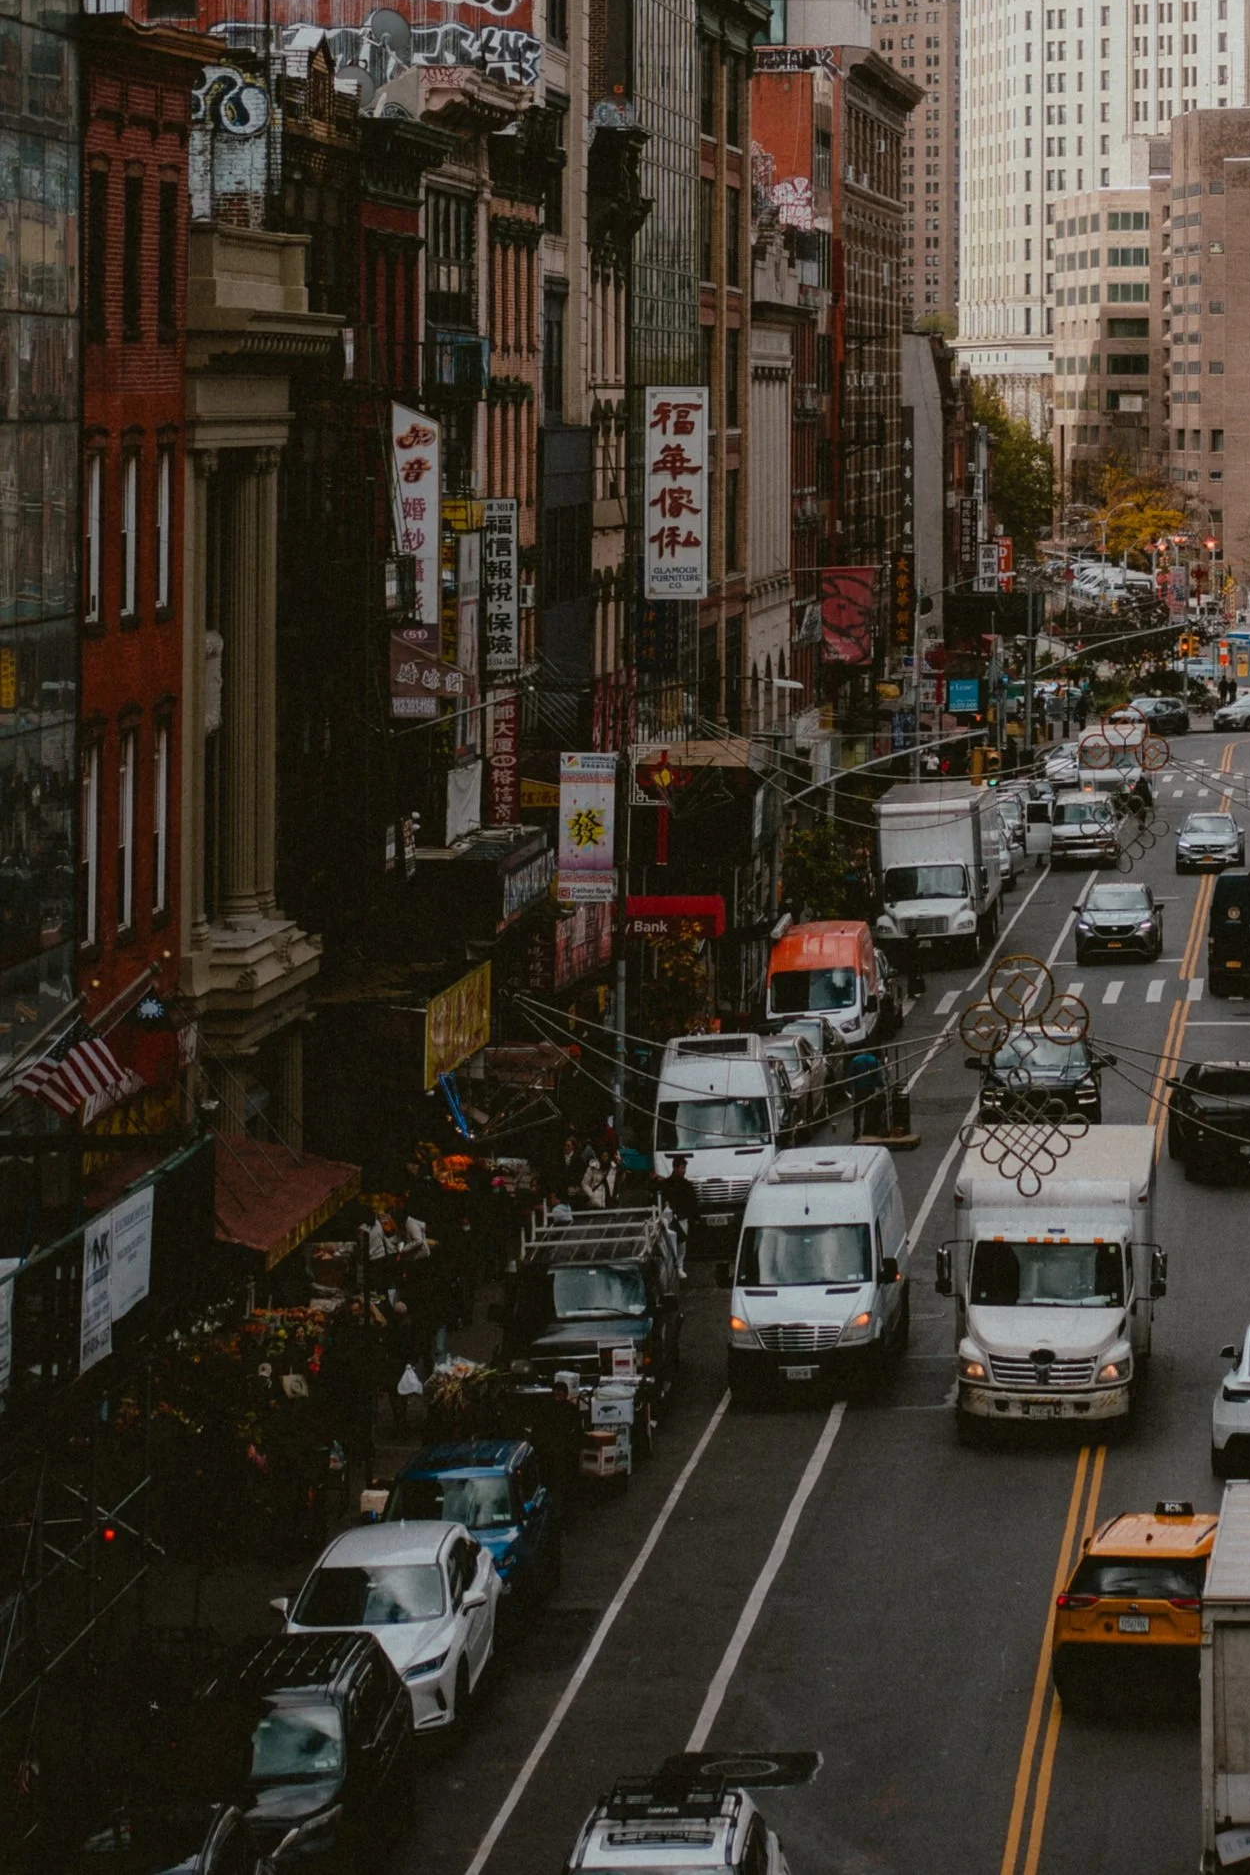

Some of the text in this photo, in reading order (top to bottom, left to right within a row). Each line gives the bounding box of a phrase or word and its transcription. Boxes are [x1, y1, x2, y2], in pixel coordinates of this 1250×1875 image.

[395, 425, 435, 484] 知音
[649, 401, 703, 558] 福華傢俬
[653, 566, 698, 574] GLAMOUR
[651, 574, 700, 582] FURNITURE
[571, 809, 602, 846] 發
[571, 886, 612, 896] Cathay Bank
[571, 893, 608, 901] Foundation
[634, 921, 668, 933] Bank
